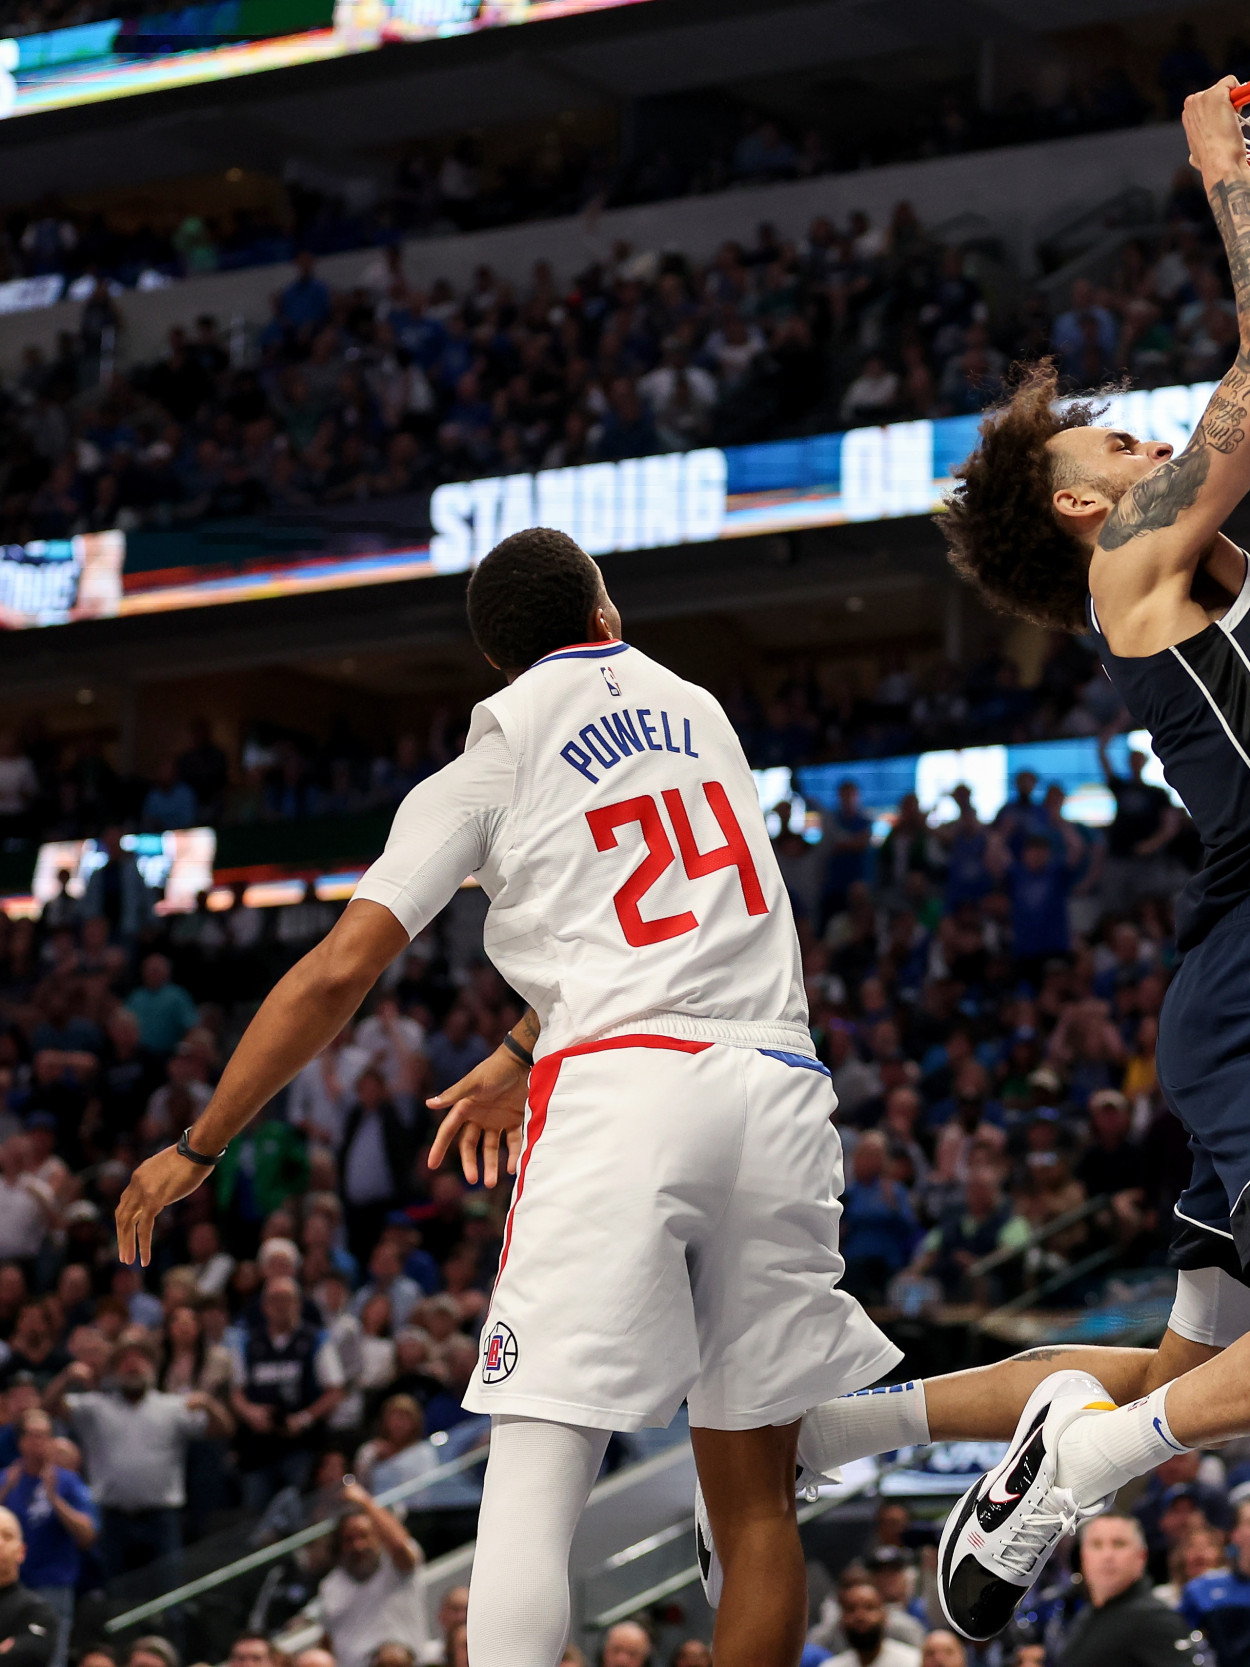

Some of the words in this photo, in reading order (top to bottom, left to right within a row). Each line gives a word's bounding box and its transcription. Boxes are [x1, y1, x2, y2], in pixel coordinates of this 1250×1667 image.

[429, 447, 728, 576] STANDING
[559, 709, 699, 784] POWELL
[584, 780, 770, 947] 24
